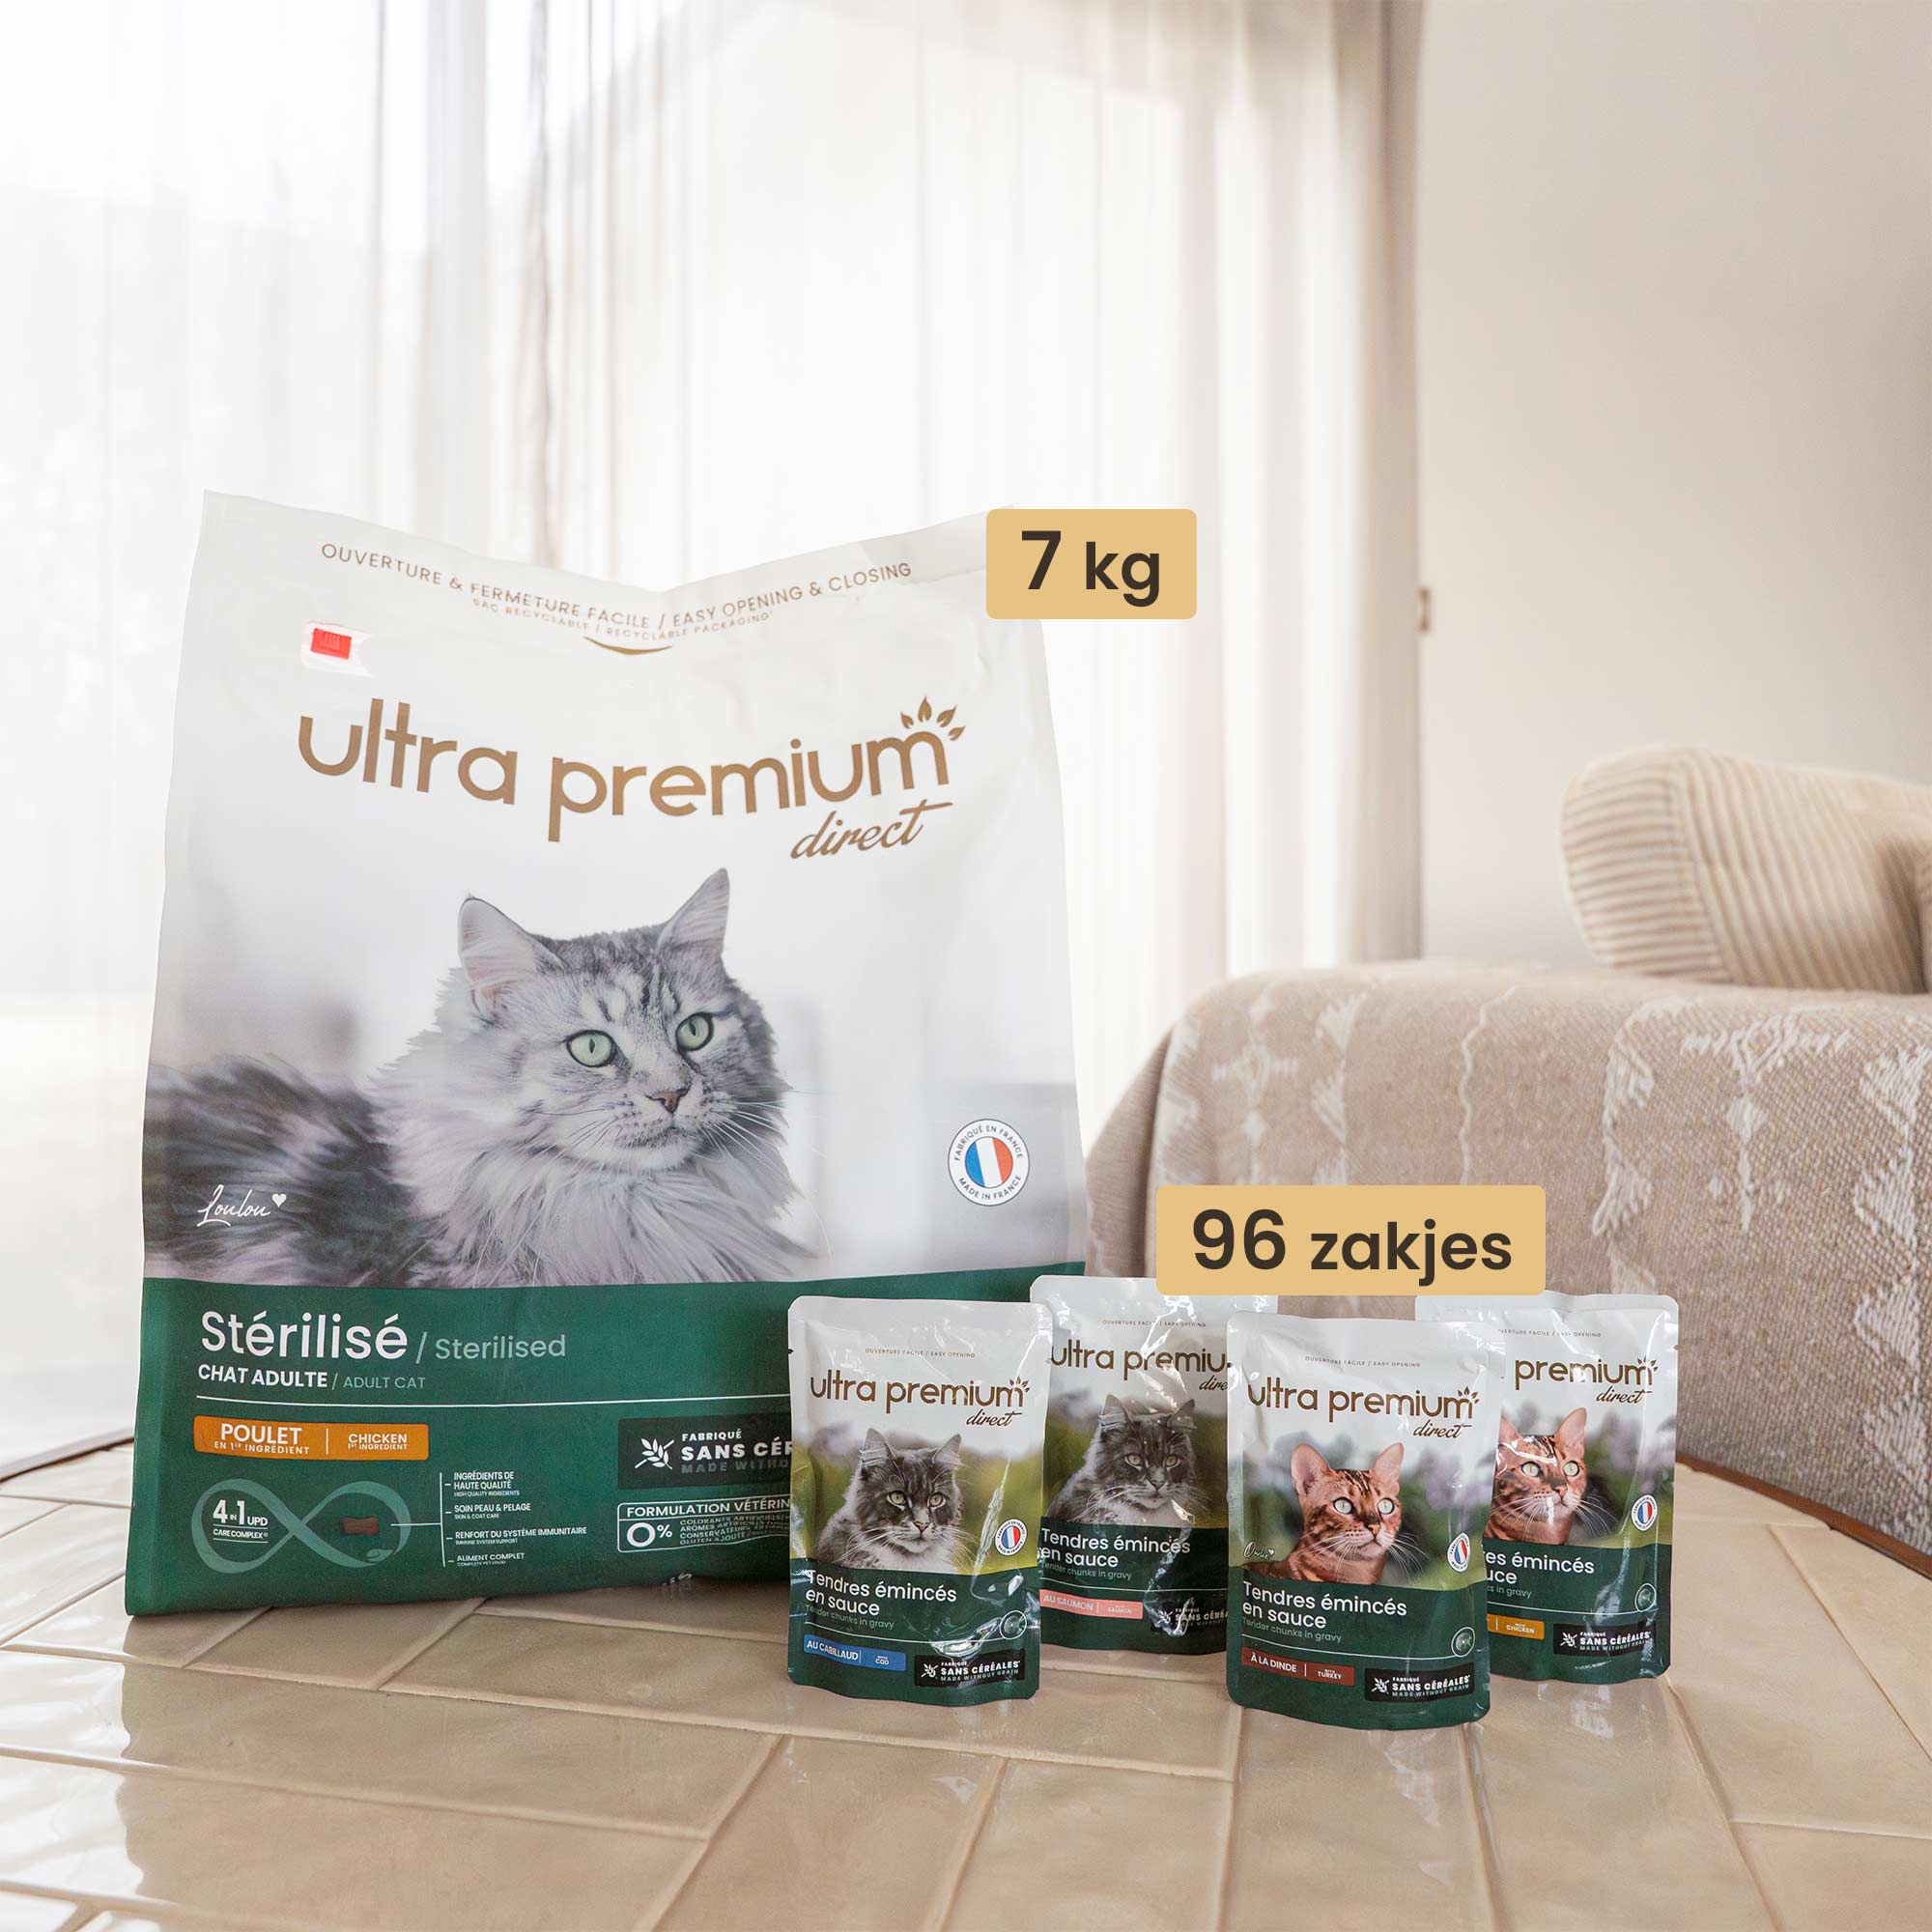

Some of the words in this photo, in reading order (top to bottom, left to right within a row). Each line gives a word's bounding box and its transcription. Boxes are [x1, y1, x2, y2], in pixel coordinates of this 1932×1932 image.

[322, 543, 441, 585] OUVERTURE
[449, 577, 463, 591] &
[470, 582, 581, 616] FERMETURE
[587, 608, 650, 629] FACILE
[673, 607, 717, 627] EASY
[723, 586, 803, 616] OPENING
[810, 582, 822, 596] &
[829, 562, 912, 592] CLOSING
[472, 598, 498, 612] SAC
[298, 698, 518, 805] ultra
[548, 730, 950, 843] premium
[790, 799, 953, 859] direct
[953, 1125, 982, 1161] FABRIQUÉ
[1000, 1128, 1023, 1158] FRANCE
[958, 1178, 980, 1198] MADE
[993, 1176, 1021, 1199] FRANCE
[196, 1184, 270, 1227] Loulou
[201, 1310, 409, 1359] Stérilisé
[436, 1334, 566, 1361] Sterilised
[1051, 1339, 1115, 1371] ultra
[198, 1364, 248, 1384] CHAT
[251, 1369, 328, 1388] ADULTE
[343, 1376, 390, 1389] ADULT
[394, 1376, 426, 1389] CAT
[1515, 1358, 1653, 1391] premium
[810, 1369, 876, 1402] ultra
[886, 1379, 1023, 1414] premium
[1247, 1377, 1318, 1410] ultra
[1328, 1389, 1473, 1423] premium
[1596, 1385, 1653, 1404] direct
[965, 1407, 1023, 1427] direct
[220, 1423, 302, 1445] POULET
[348, 1434, 408, 1443] CHICKEN
[682, 1429, 742, 1442] FABRIQUÉ
[1412, 1419, 1472, 1439] direct
[213, 1440, 226, 1449] EN
[244, 1443, 310, 1455] INGRÉDIENT
[681, 1443, 746, 1462] SANS
[453, 1470, 502, 1480] INGRÉDIENTS
[503, 1471, 515, 1480] DE
[681, 1462, 727, 1474] MADE
[453, 1481, 479, 1490] HAUTE
[480, 1479, 512, 1490] QUALITÉ
[213, 1499, 228, 1523] 4
[237, 1500, 244, 1524] 1
[247, 1516, 269, 1526] UPD
[454, 1504, 473, 1513] SOIN
[474, 1504, 495, 1513] PEAU
[495, 1503, 501, 1512] &
[502, 1502, 531, 1512] PELAGE
[627, 1501, 730, 1519] FORMULATION
[733, 1497, 790, 1512] VÉTÉRIN
[455, 1530, 490, 1539] RENFORT
[502, 1527, 537, 1538] SYSTÈME
[537, 1526, 587, 1536] IMMUNITAIRE
[1041, 1527, 1109, 1550] Tendres
[1113, 1534, 1191, 1554] émincés
[456, 1553, 488, 1562] ALIMENT
[1041, 1547, 1061, 1561] en
[1065, 1551, 1119, 1568] sauce
[1511, 1550, 1595, 1574] émincés
[1066, 1567, 1096, 1577] chunks
[1097, 1569, 1106, 1577] in
[1107, 1571, 1132, 1581] gravy
[806, 1569, 870, 1597] Tendres
[874, 1580, 957, 1603] émincés
[1496, 1585, 1505, 1594] in
[1506, 1588, 1532, 1599] gravy
[805, 1589, 825, 1605] en
[828, 1595, 880, 1616] sauce
[1043, 1594, 1056, 1603] AU
[1056, 1596, 1094, 1611] SAUMON
[1242, 1580, 1316, 1609] Tendres
[1321, 1592, 1407, 1617] émincés
[805, 1605, 830, 1617] Teder
[831, 1611, 859, 1625] chunks
[859, 1617, 867, 1626] in
[868, 1619, 895, 1630] gravy
[1242, 1602, 1263, 1619] en
[1267, 1608, 1327, 1629] sauce
[1242, 1617, 1269, 1631] Tender
[1270, 1626, 1303, 1638] chunks
[1304, 1630, 1313, 1639] in
[1315, 1632, 1342, 1643] gravy
[806, 1640, 819, 1649] AU
[818, 1642, 859, 1661] CABILLAUD
[1579, 1637, 1607, 1646] SANS
[940, 1666, 969, 1676] SANS
[1250, 1651, 1257, 1662] À
[1258, 1656, 1269, 1665] LA
[1269, 1660, 1297, 1673] DINDE
[964, 1672, 995, 1681] WITHOUT
[1317, 1670, 1342, 1680] TURKEY
[1392, 1683, 1422, 1691] SANS
